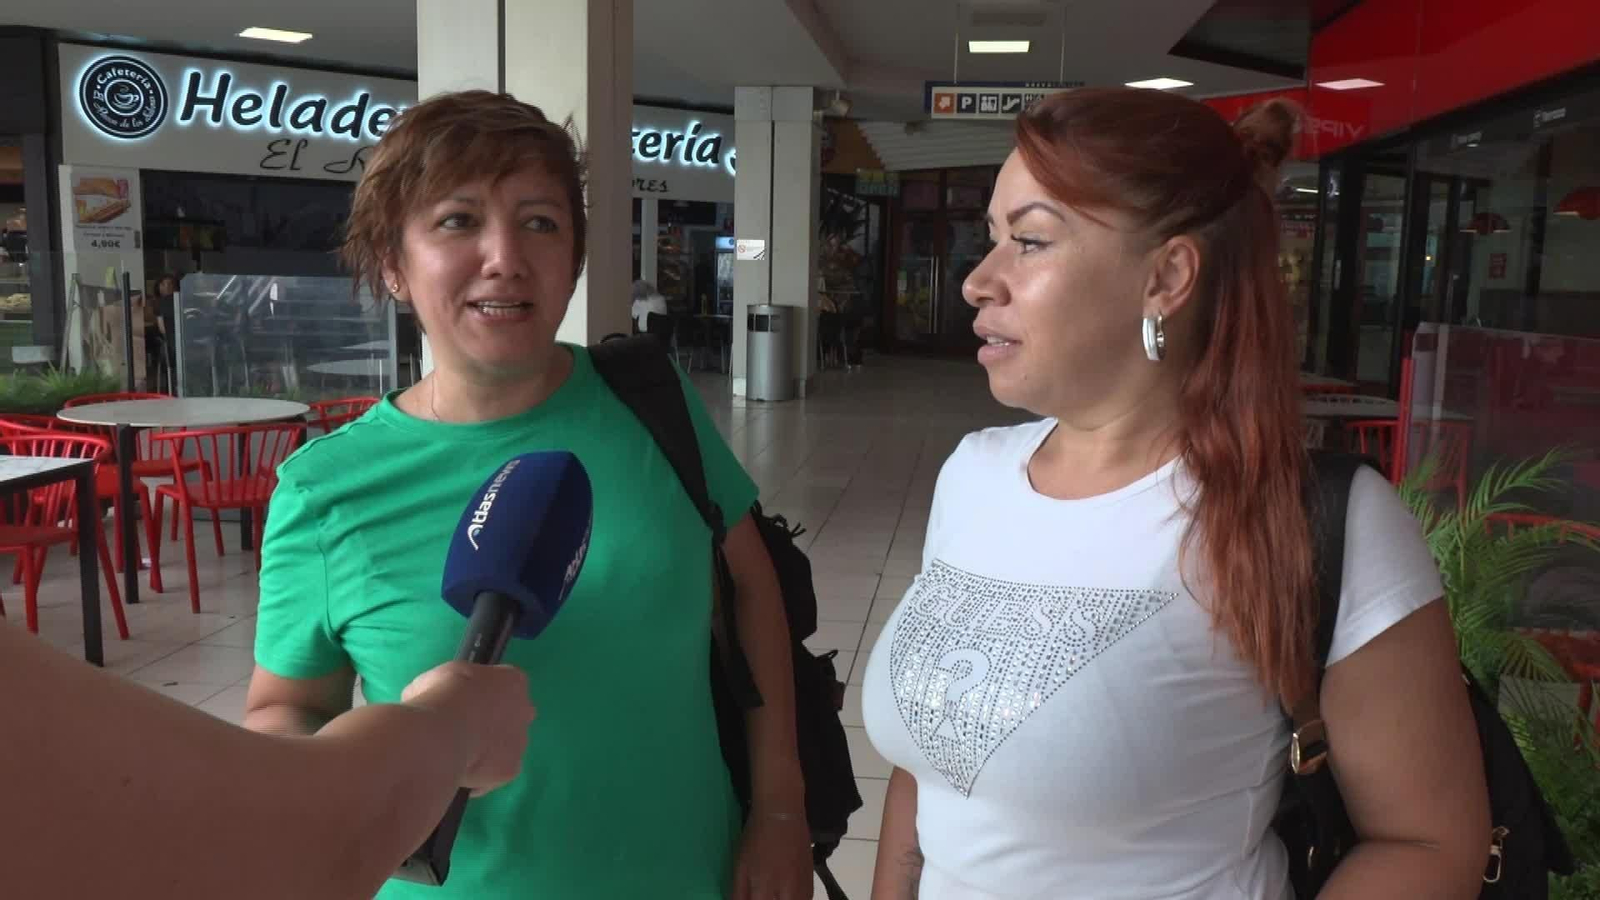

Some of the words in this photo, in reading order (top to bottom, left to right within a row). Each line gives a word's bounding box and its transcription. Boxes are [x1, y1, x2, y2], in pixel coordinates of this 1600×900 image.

[179, 71, 400, 139] Helade
[961, 96, 973, 109] P
[259, 138, 309, 171] El
[912, 582, 1102, 647] GUESS
